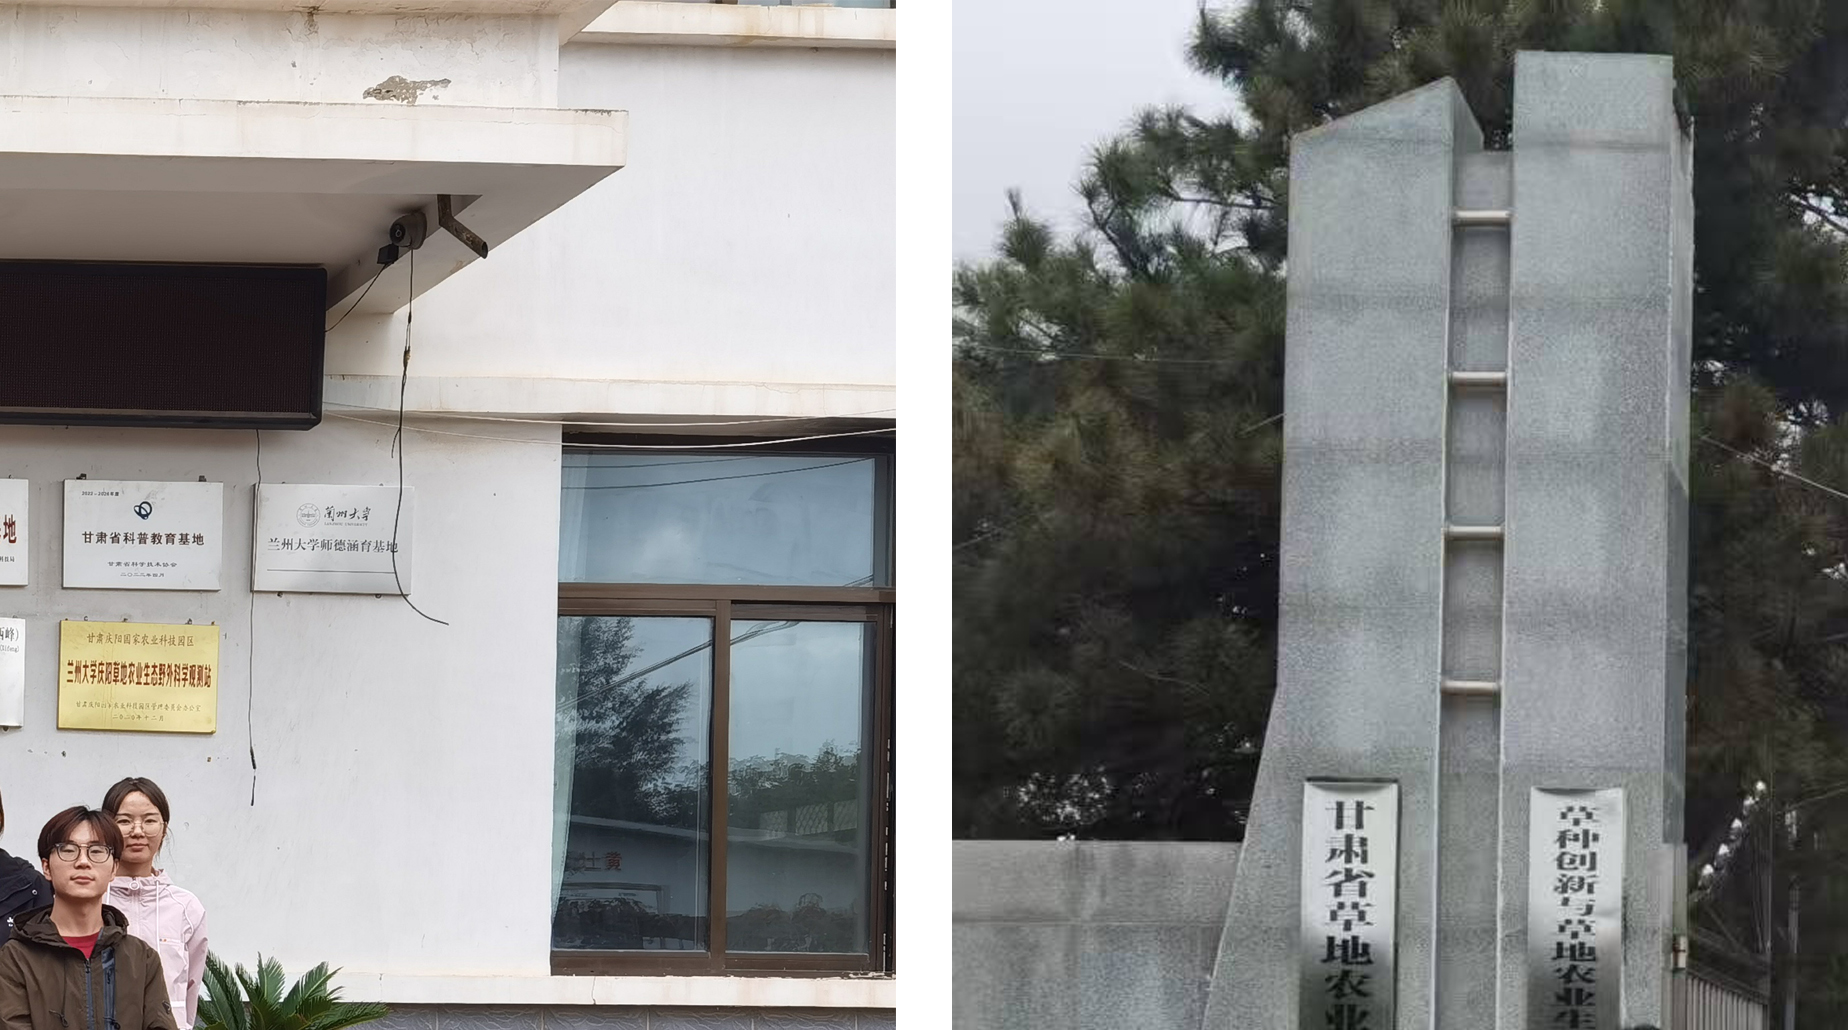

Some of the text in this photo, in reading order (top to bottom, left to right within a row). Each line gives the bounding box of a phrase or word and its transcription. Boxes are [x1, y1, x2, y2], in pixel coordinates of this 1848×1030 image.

[82, 531, 205, 546] 甘肃省科普教育基地
[267, 537, 399, 553] 兰州大学师德涵育基地
[86, 633, 194, 647] 甘肃庆阳国家农业科技园区
[66, 660, 212, 688] 兰州大学庆阳草地农业生态野外科学观测站
